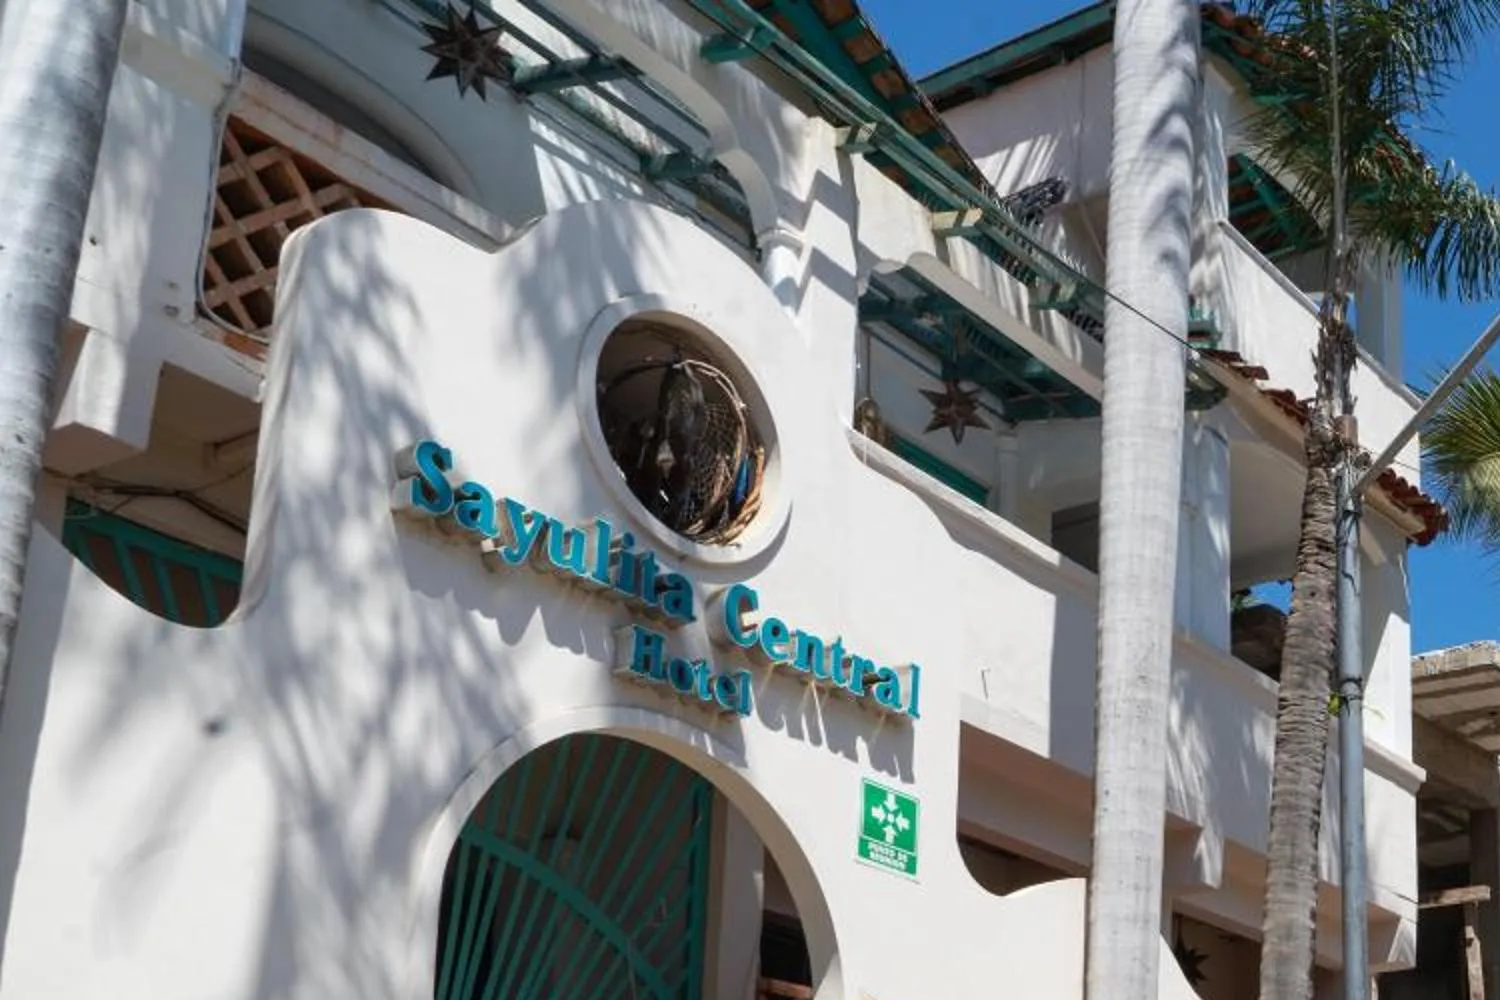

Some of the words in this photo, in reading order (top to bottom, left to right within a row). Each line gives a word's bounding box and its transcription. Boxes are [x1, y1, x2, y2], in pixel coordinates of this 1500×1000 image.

[411, 440, 697, 625] Sayulita
[724, 583, 920, 720] Central
[630, 623, 752, 718] Hotel
